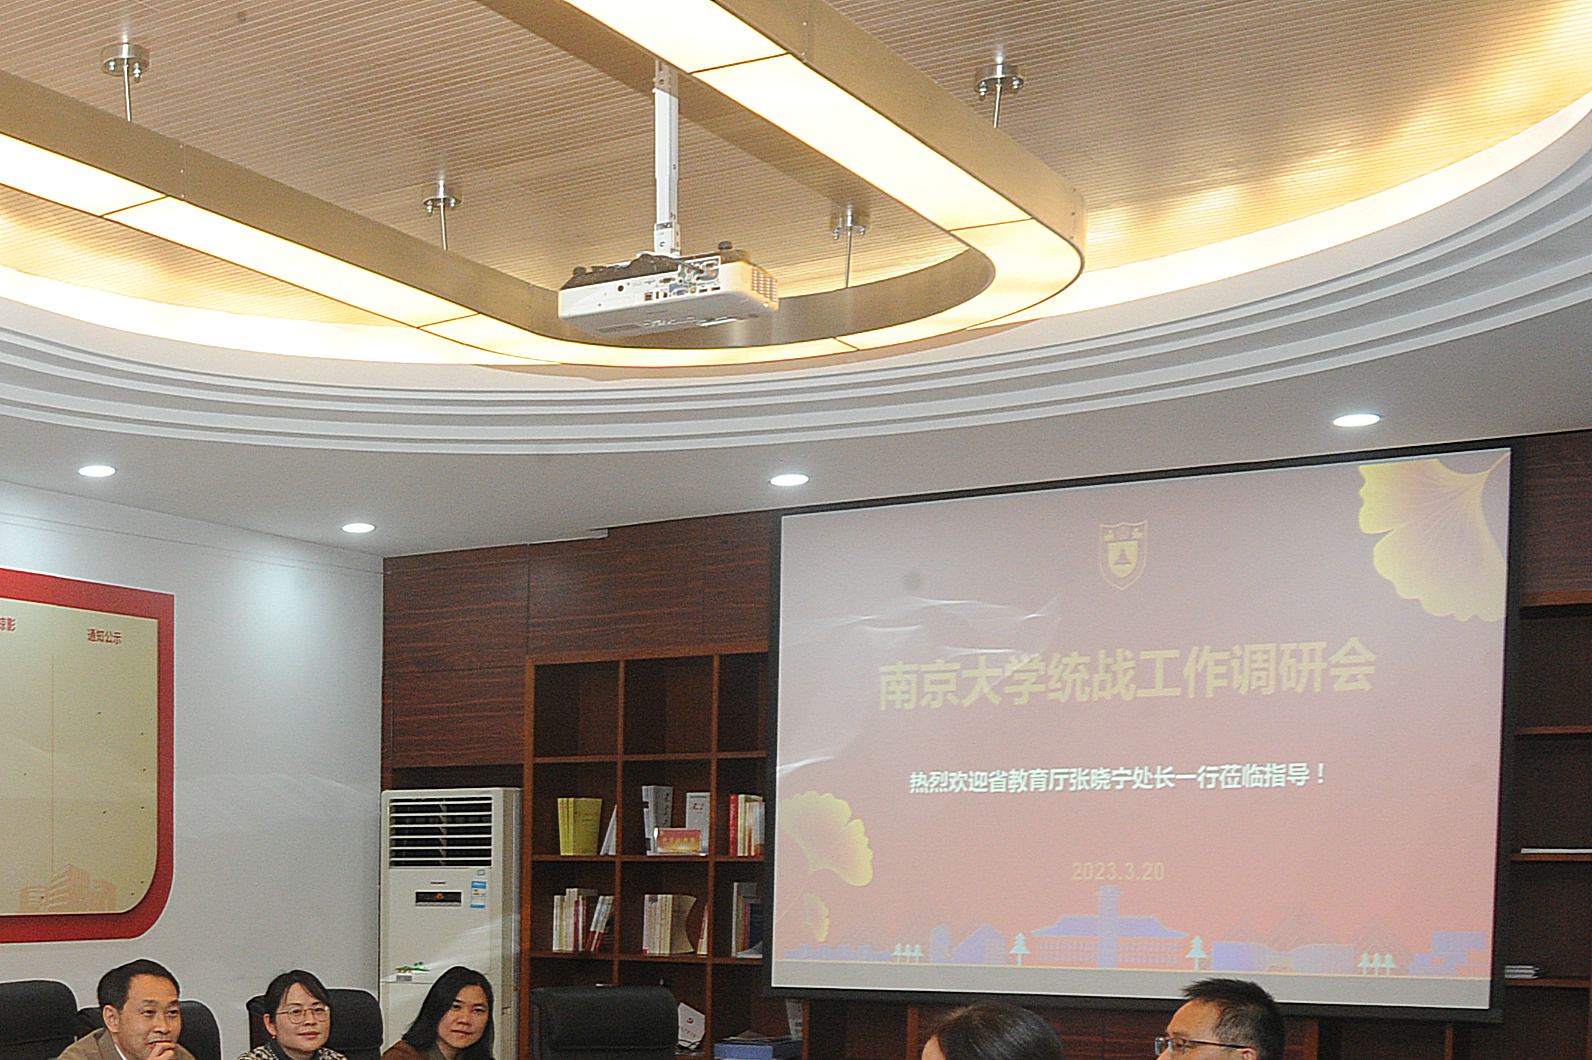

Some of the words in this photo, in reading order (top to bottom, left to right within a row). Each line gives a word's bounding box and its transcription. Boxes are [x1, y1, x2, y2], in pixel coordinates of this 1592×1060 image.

[87, 628, 123, 645] 通知公示
[878, 636, 1377, 711] 南京大学统战工作调研会
[1070, 861, 1165, 882] 2023.3.20
